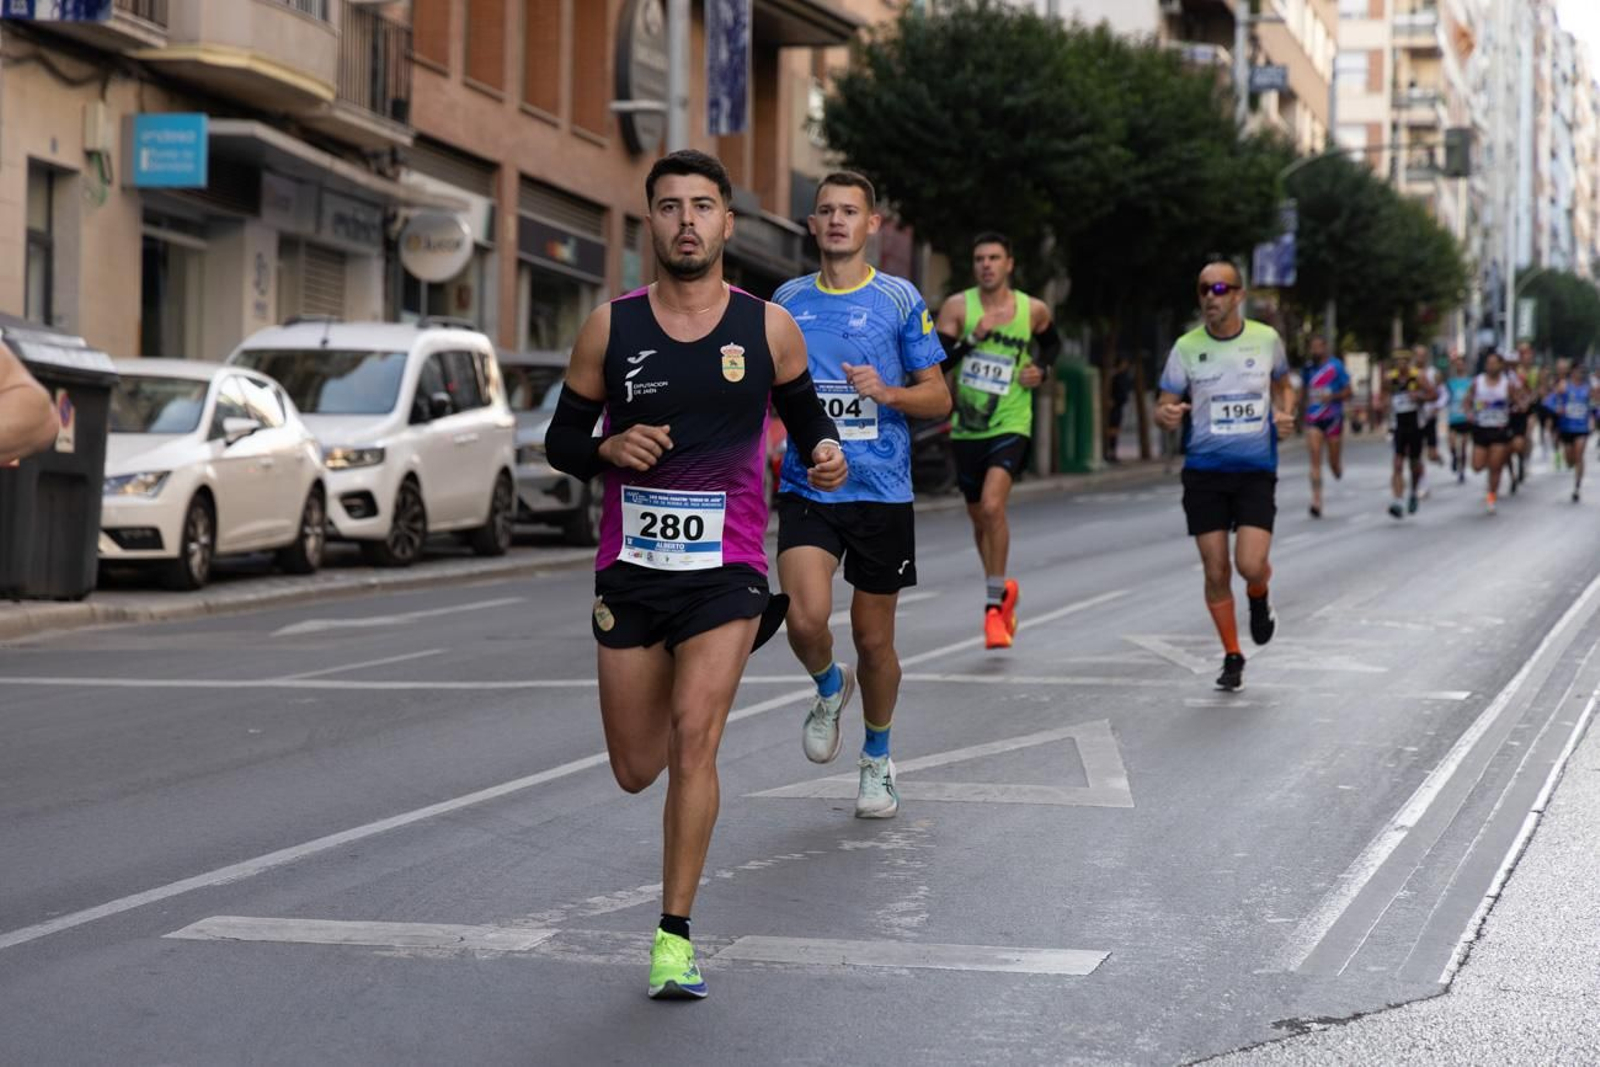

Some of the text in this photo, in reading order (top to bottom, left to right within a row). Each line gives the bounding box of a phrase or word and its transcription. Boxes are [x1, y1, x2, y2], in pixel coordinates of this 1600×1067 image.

[970, 361, 1003, 379] 619
[1222, 403, 1255, 419] 196
[640, 511, 705, 541] 280
[655, 541, 686, 550] ALBERTO
